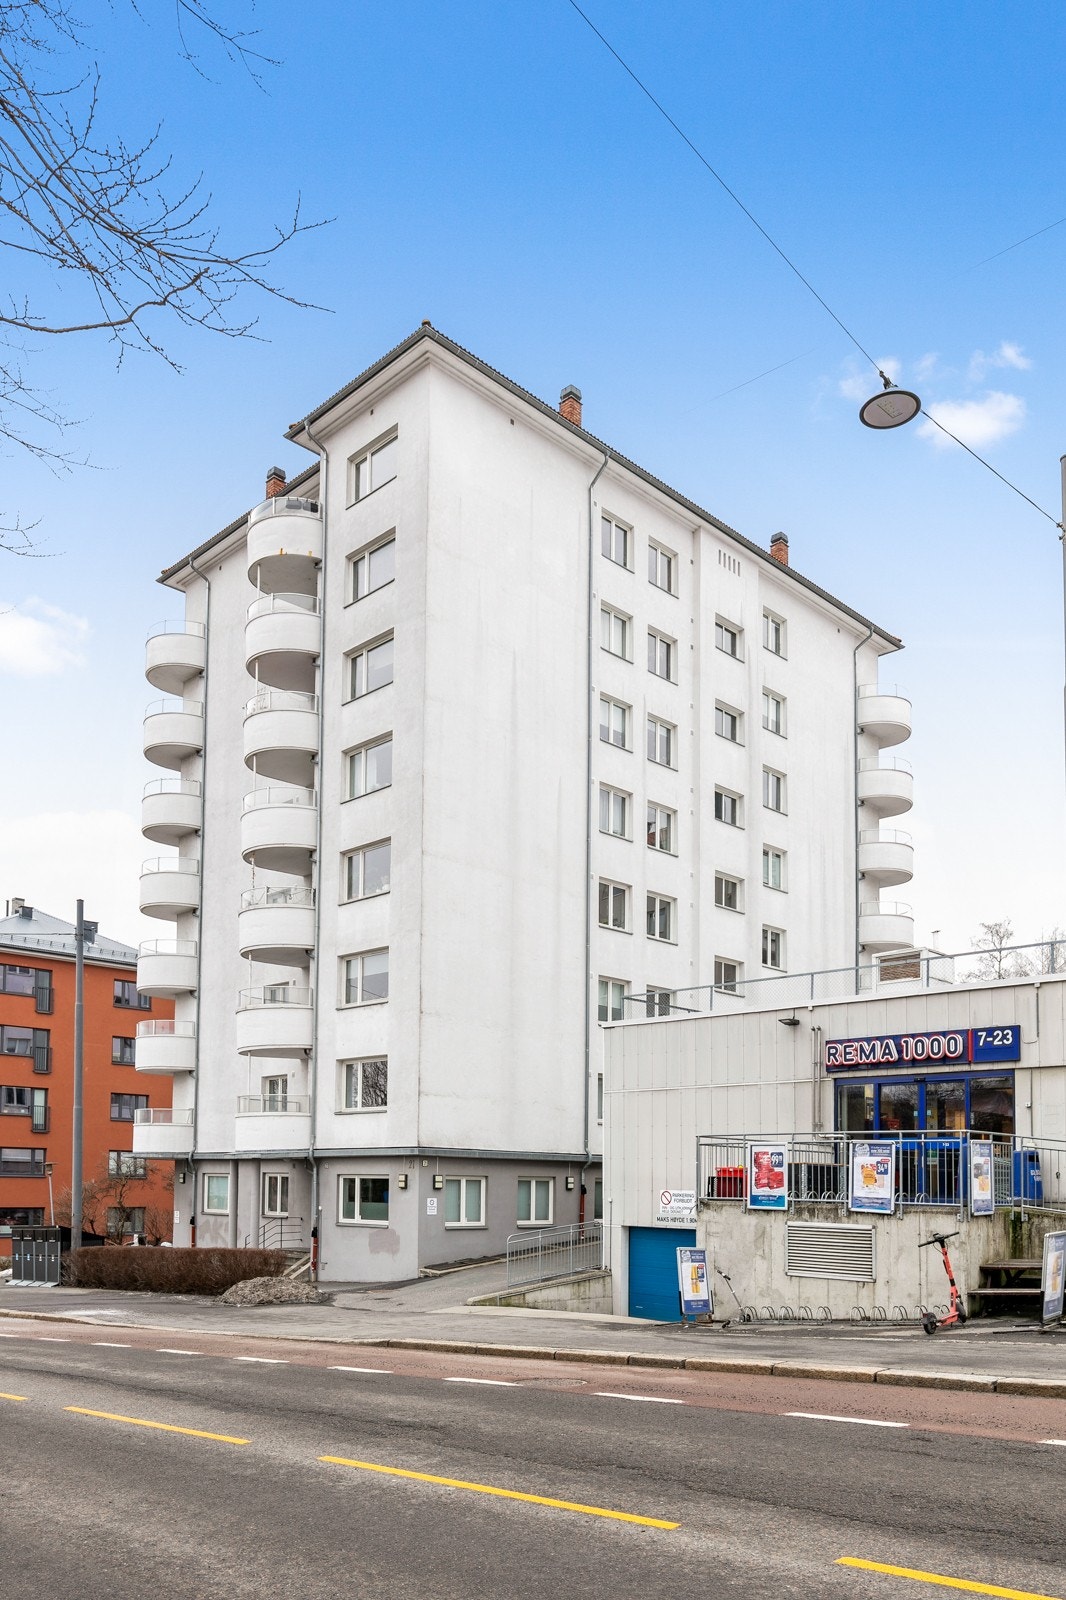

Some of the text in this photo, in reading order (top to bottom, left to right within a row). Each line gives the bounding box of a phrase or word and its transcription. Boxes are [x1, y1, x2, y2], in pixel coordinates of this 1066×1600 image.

[826, 1034, 963, 1065] REMA 1000
[977, 1029, 1014, 1046] 7-23
